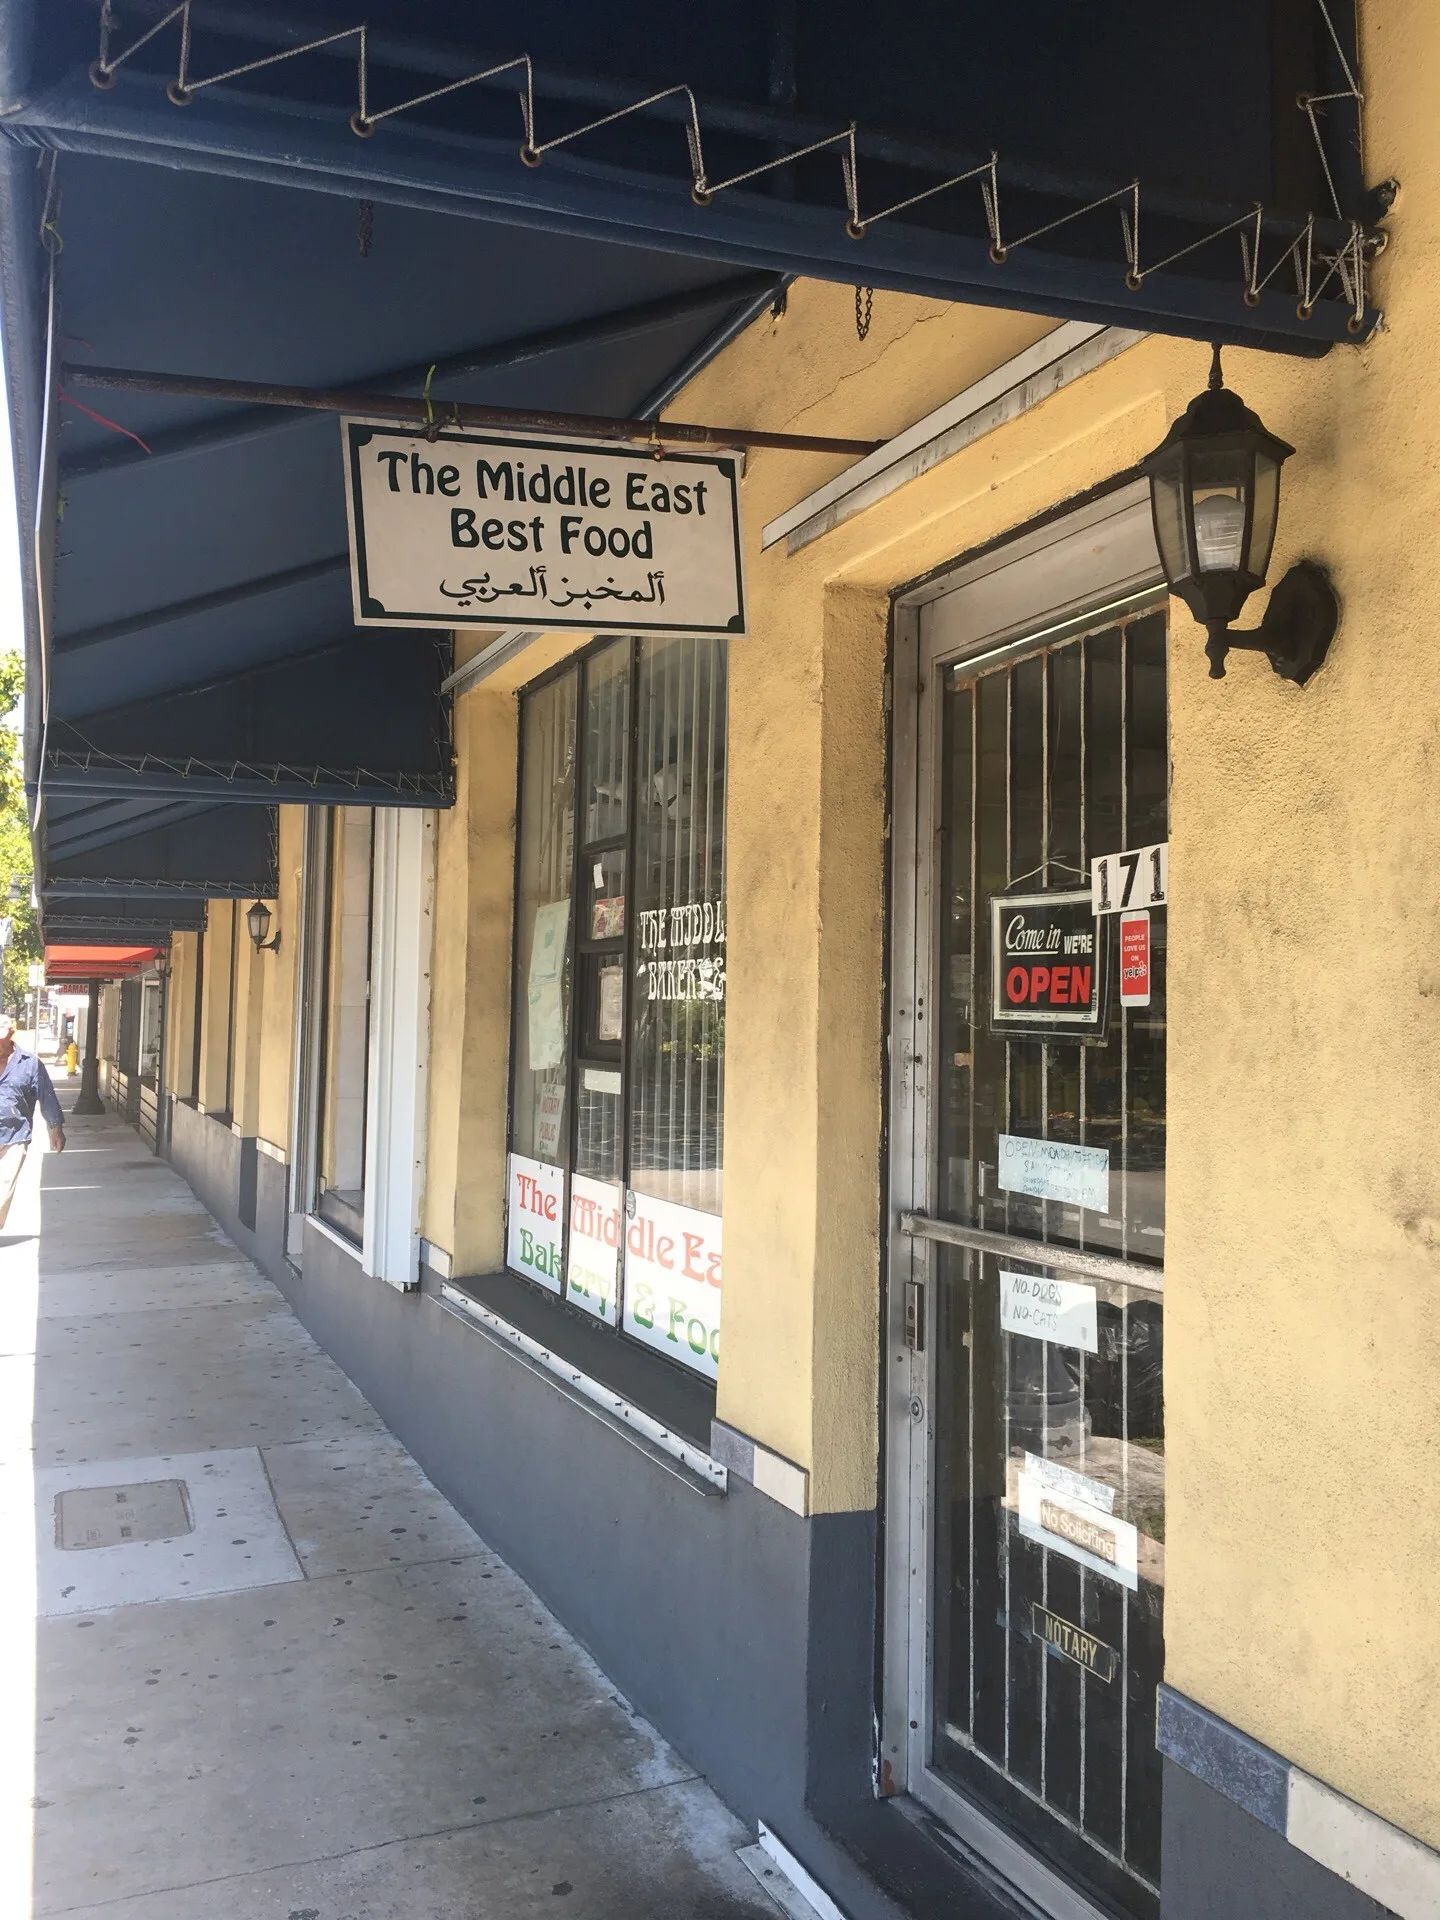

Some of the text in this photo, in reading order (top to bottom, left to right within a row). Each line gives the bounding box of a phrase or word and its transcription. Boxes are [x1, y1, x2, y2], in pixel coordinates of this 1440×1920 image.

[377, 451, 708, 516] The Middle East
[450, 507, 654, 560] Best Food
[1097, 847, 1165, 912] 171
[640, 900, 728, 957] THE MIDDL
[1005, 914, 1093, 955] Come in WE'RE
[1124, 934, 1145, 942] PEOPLE
[1005, 965, 1091, 1004] OPEN
[1123, 966, 1140, 980] yelp
[516, 1173, 557, 1221] The
[572, 1194, 675, 1270] Middle
[519, 1227, 612, 1316] Bakery
[633, 1282, 656, 1329] &
[1040, 1503, 1115, 1560] No Soliciting
[1045, 1615, 1098, 1668] NOTARY
